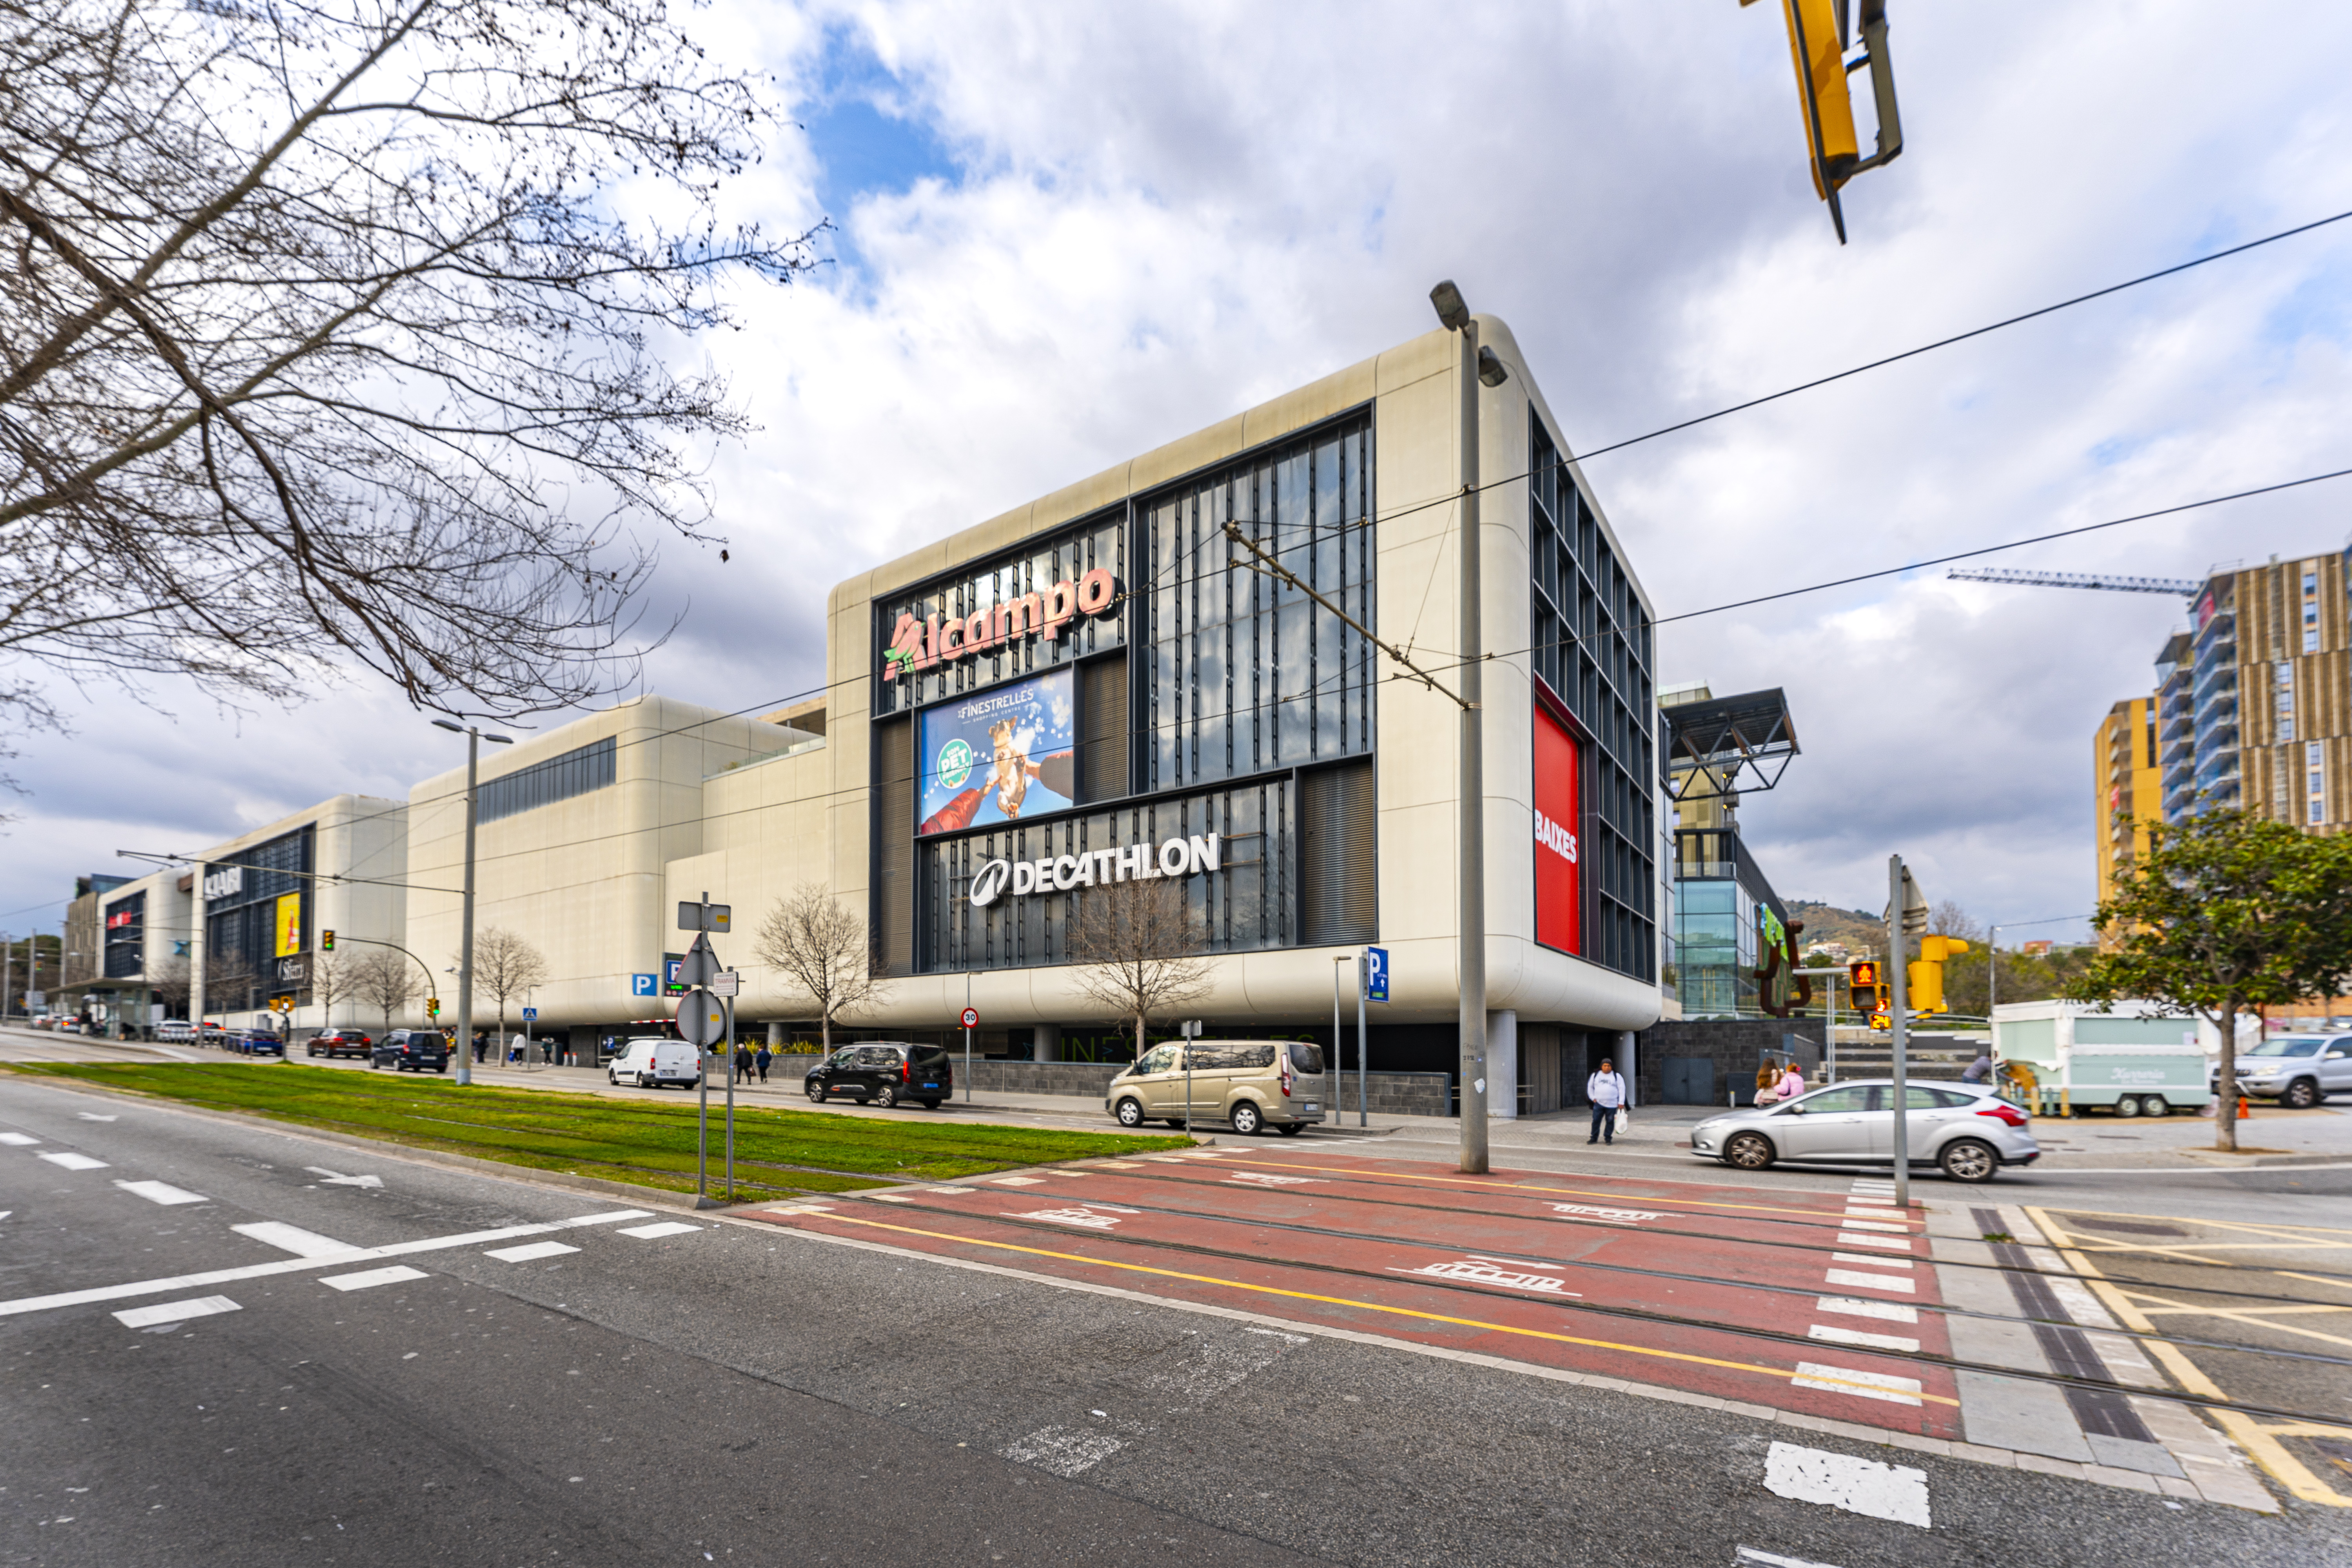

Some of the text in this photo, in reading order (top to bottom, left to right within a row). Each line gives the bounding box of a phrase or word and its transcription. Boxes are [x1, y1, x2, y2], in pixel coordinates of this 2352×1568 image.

[884, 568, 1114, 681] Alcampo
[961, 688, 1034, 719] FINESTRELLES
[973, 706, 1020, 722] SHOPPING CENTRE
[941, 748, 967, 773] PET
[947, 746, 960, 757] SOM
[942, 762, 969, 780] FRIENDLY
[1535, 809, 1577, 864] BAIXES
[1013, 833, 1220, 896] DECATHLON
[1370, 952, 1380, 986] P
[636, 976, 651, 995] P
[1873, 1015, 1889, 1028] 24
